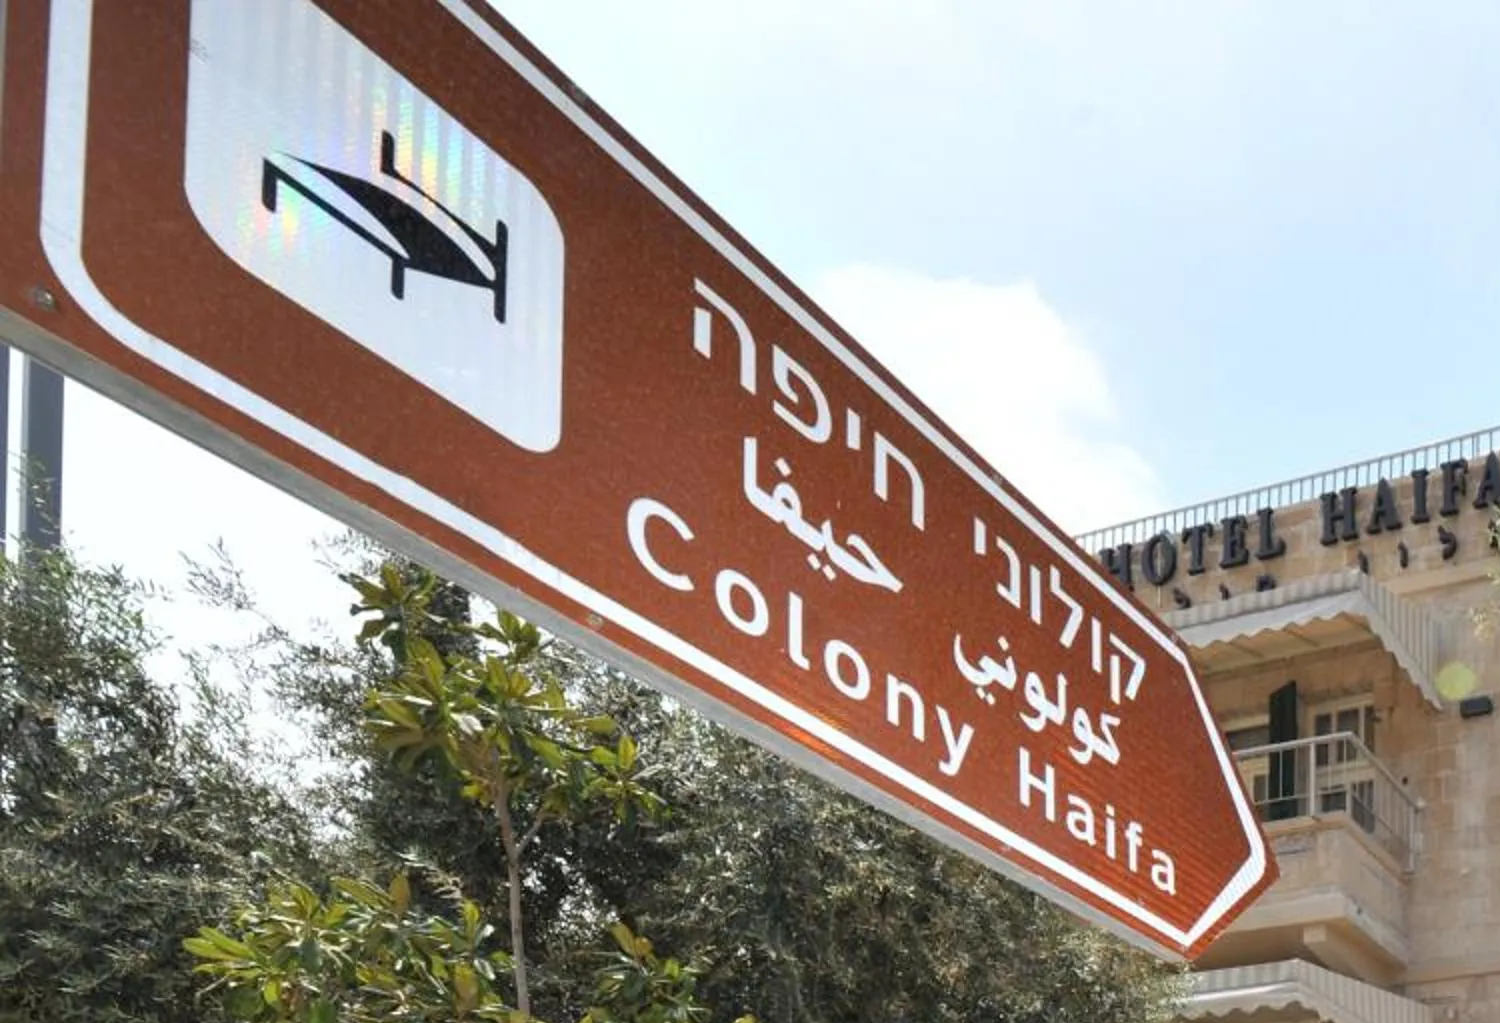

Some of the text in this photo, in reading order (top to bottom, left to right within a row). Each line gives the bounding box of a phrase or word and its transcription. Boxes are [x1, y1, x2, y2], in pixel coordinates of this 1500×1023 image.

[693, 276, 1147, 704] קולוני חיפה
[743, 436, 1121, 766] كولوني حيفا
[1101, 507, 1287, 593] HOTEL
[626, 497, 1178, 896] Colony Haifa
